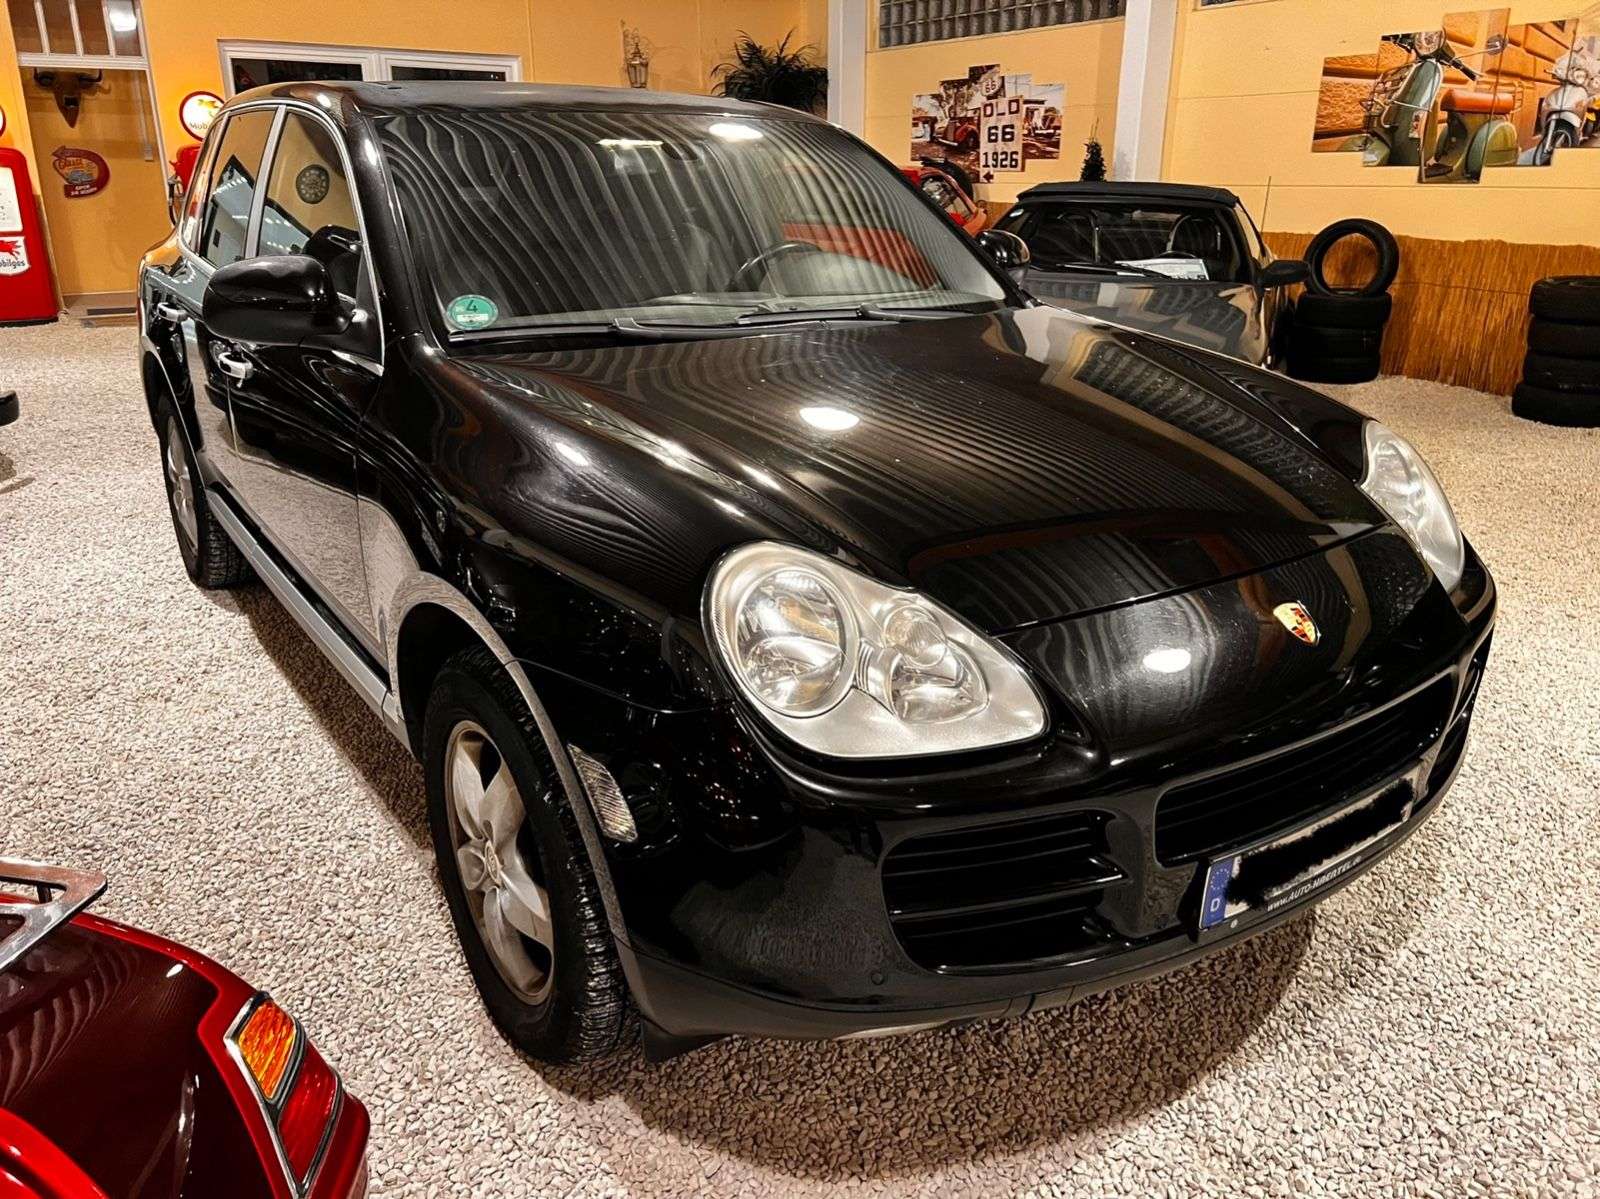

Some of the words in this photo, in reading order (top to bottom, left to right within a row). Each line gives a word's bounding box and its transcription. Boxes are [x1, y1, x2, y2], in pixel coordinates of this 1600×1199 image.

[983, 98, 1020, 118] OLD
[987, 124, 1015, 143] 66
[982, 150, 1019, 168] 1926
[466, 299, 478, 312] 4
[1210, 897, 1220, 913] D
